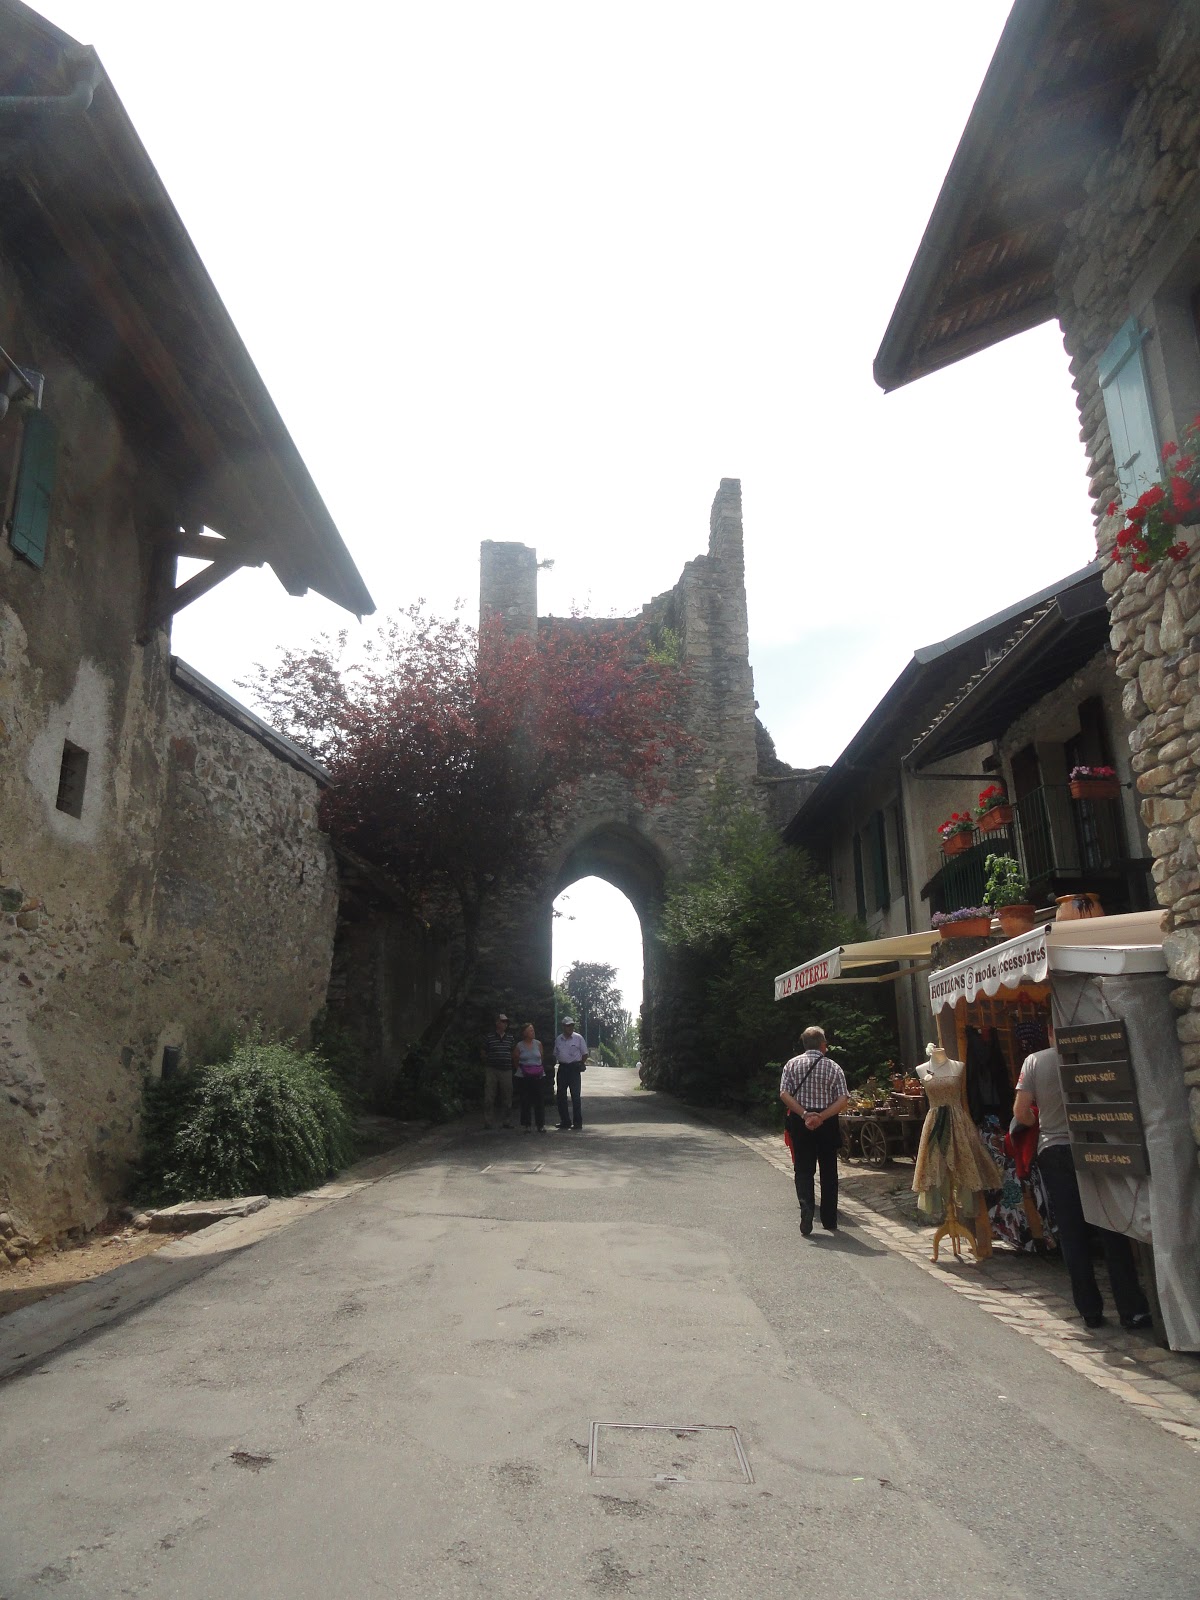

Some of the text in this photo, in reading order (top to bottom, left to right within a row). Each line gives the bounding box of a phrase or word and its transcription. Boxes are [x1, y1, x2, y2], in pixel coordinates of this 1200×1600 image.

[997, 946, 1046, 975] ccessoires
[783, 961, 829, 995] LA POTERIE
